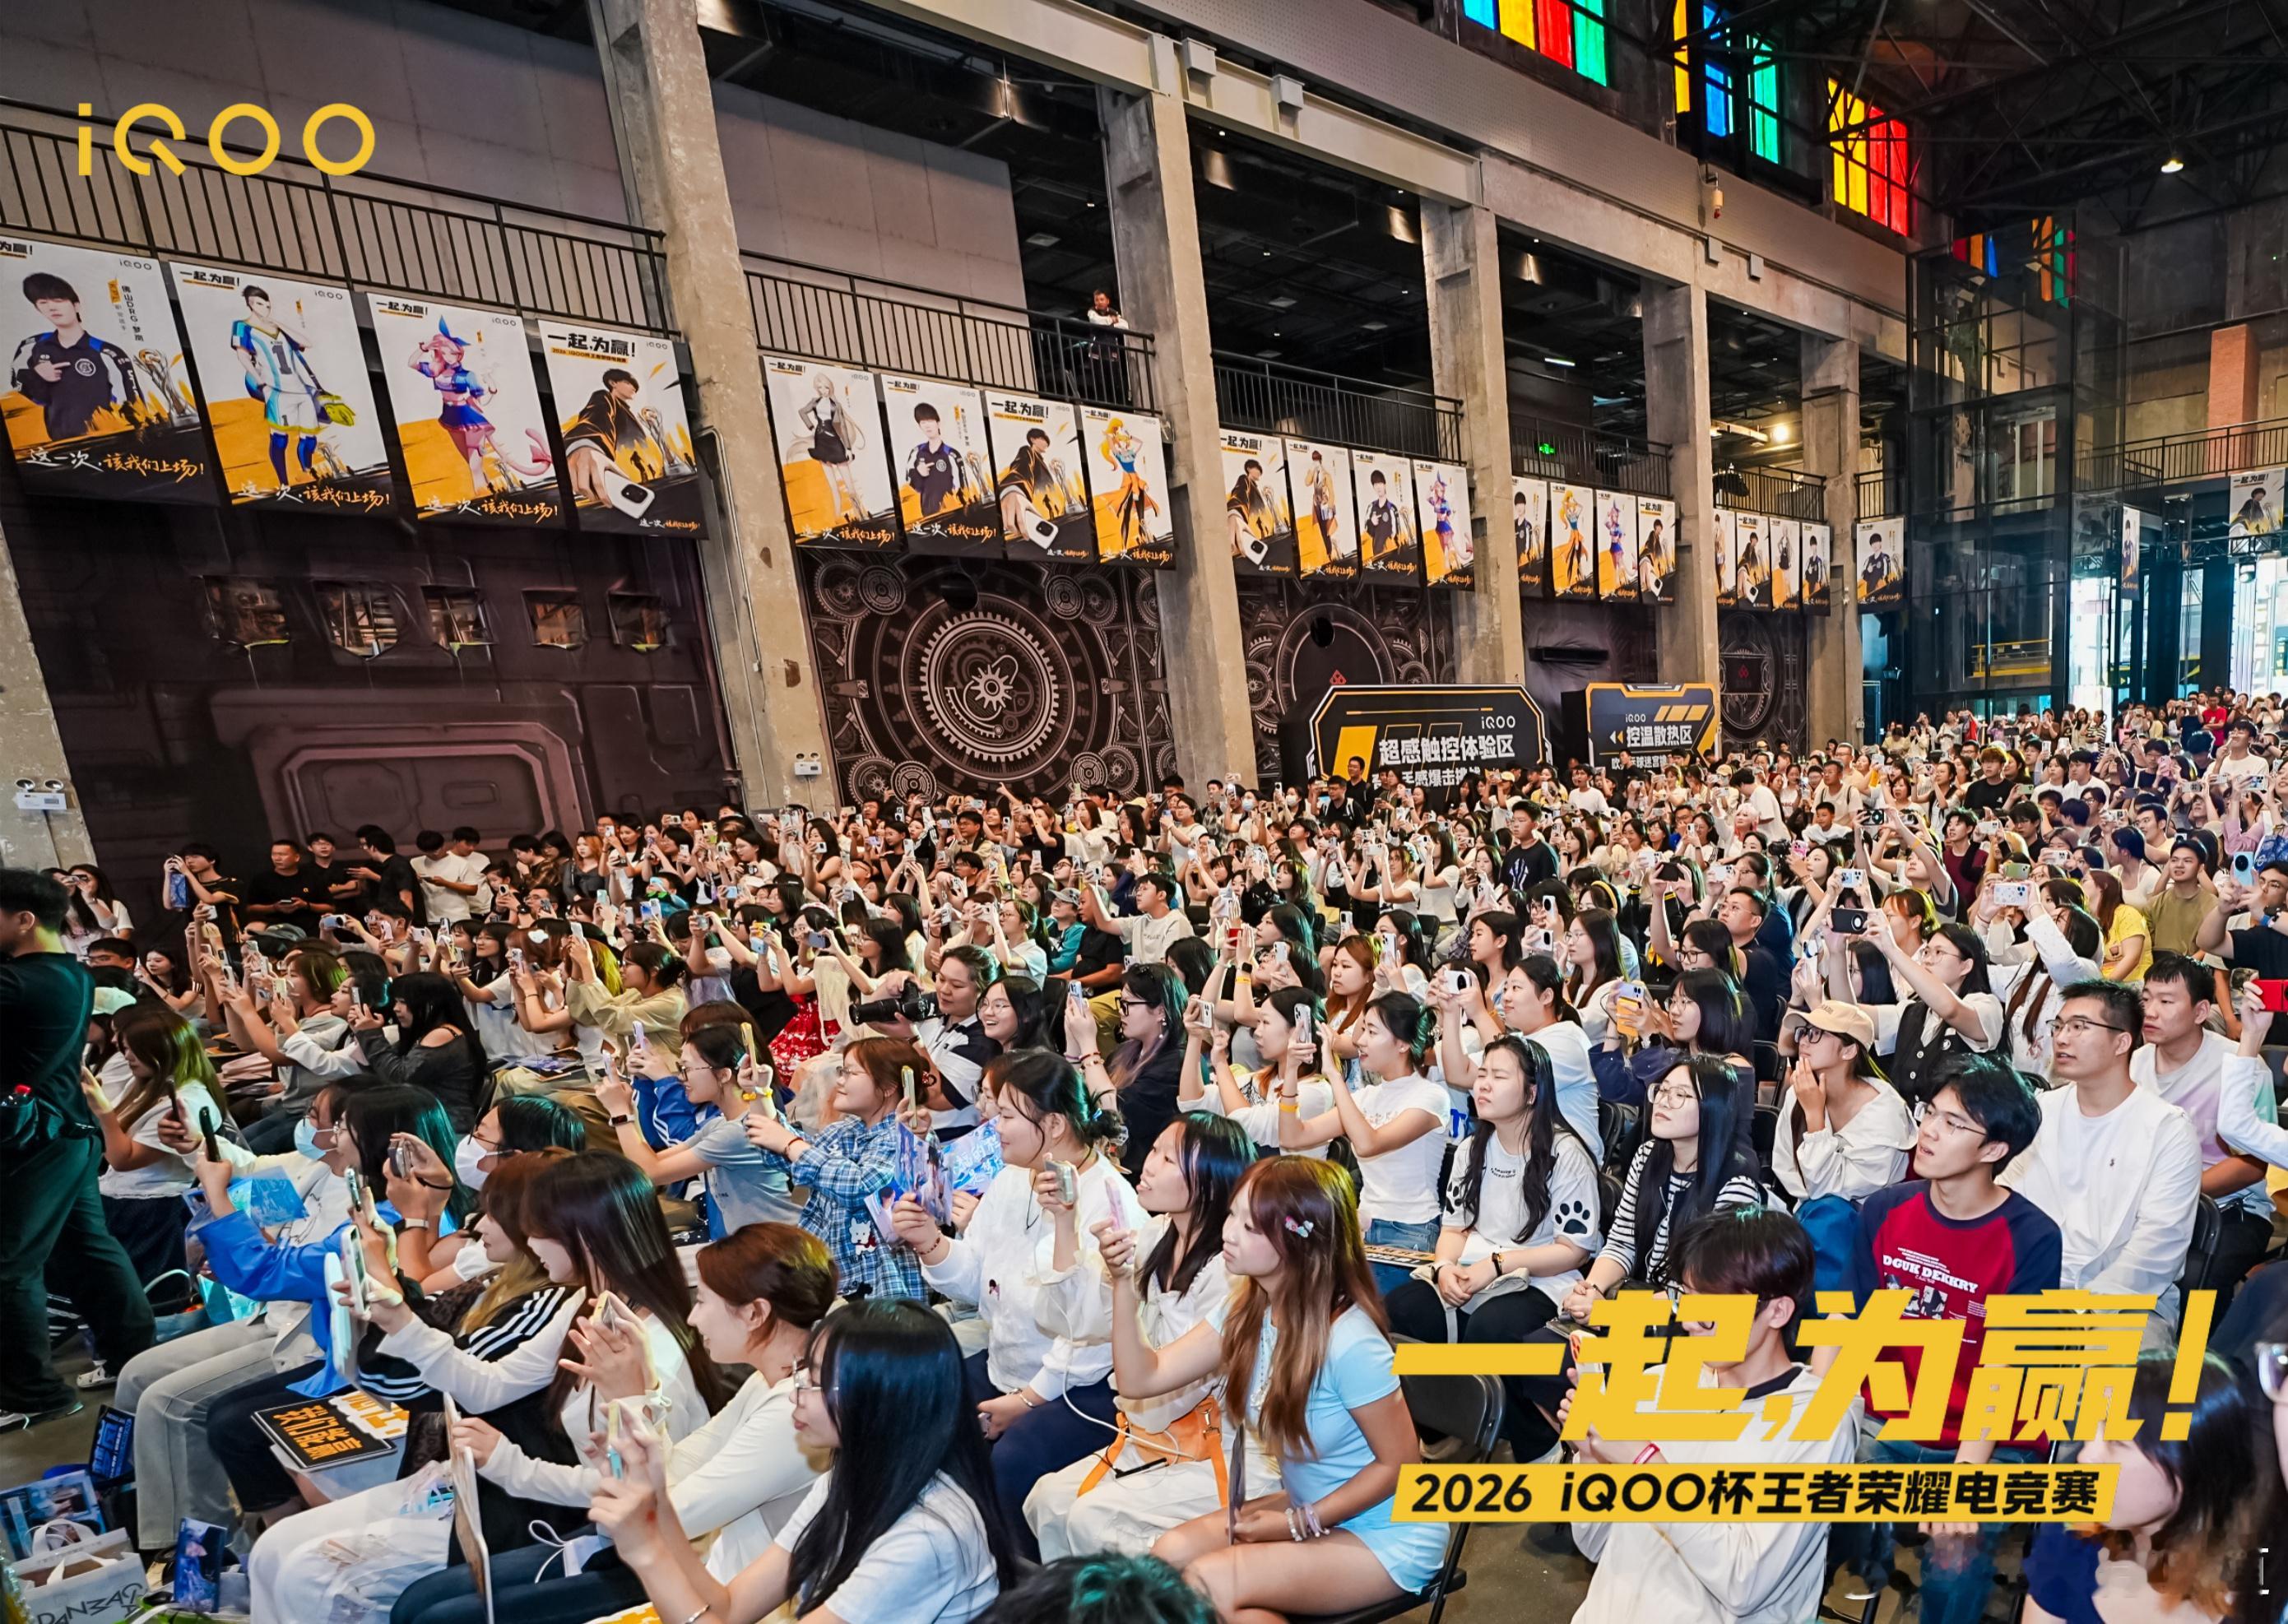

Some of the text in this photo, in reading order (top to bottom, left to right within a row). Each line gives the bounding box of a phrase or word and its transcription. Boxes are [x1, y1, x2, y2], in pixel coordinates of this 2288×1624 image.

[119, 258, 152, 271] iQOO
[548, 333, 635, 357] 一起,为赢!
[991, 400, 1048, 418] 一起,为赢!
[1481, 715, 1516, 729] iQOO
[1625, 713, 1646, 723] iQOO
[1626, 725, 1692, 748] 控温散热区
[1379, 735, 1515, 765] 超感触控体验区
